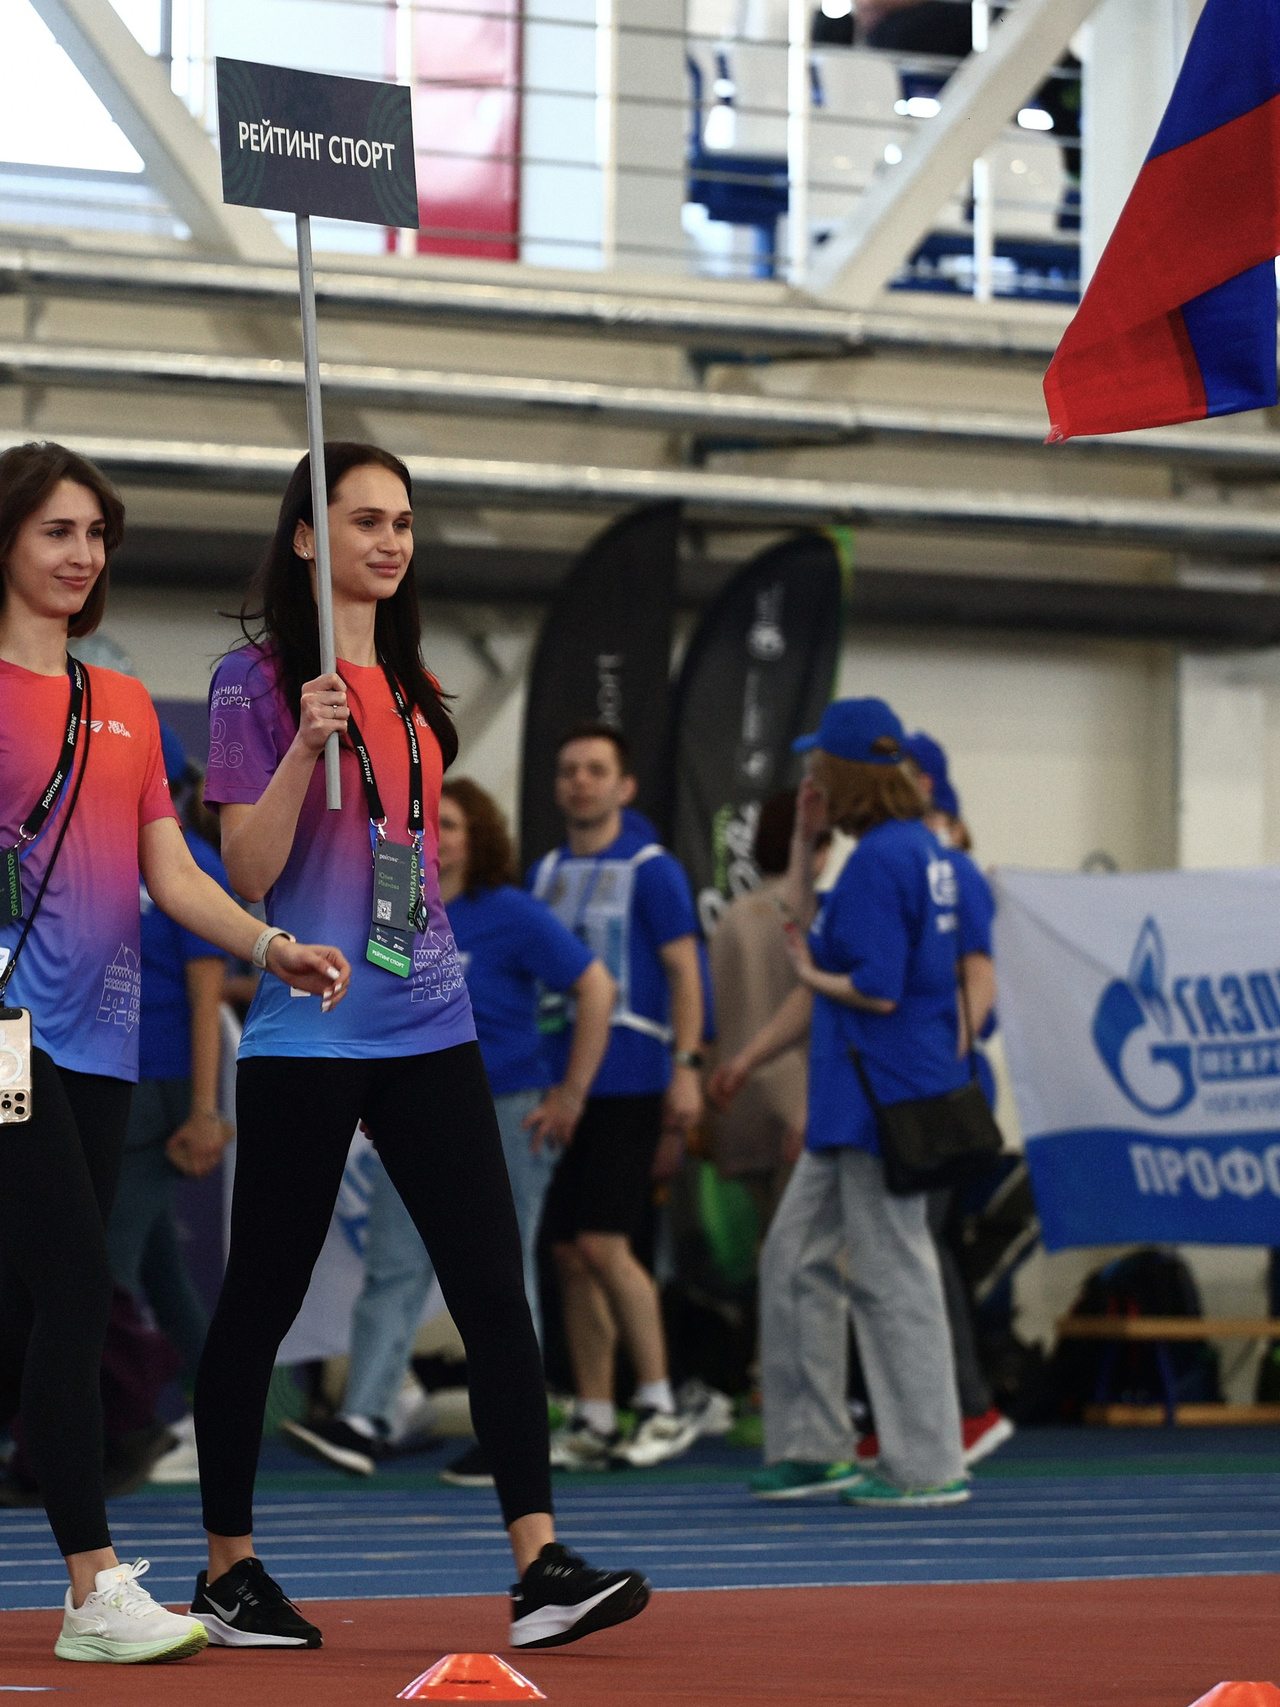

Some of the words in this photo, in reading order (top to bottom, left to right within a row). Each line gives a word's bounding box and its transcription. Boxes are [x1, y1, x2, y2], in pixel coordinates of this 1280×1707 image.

[238, 118, 324, 161] РЕЙТИНГ
[328, 135, 395, 171] СПОРТ
[67, 713, 78, 746] рейтинг
[42, 770, 64, 809] рейтинг
[357, 745, 373, 785] рейтинг
[6, 852, 19, 917] ОРГАНИЗАТОР
[408, 854, 418, 927] ОРГАНИЗАТОР
[1173, 969, 1280, 1035] ГАЗП
